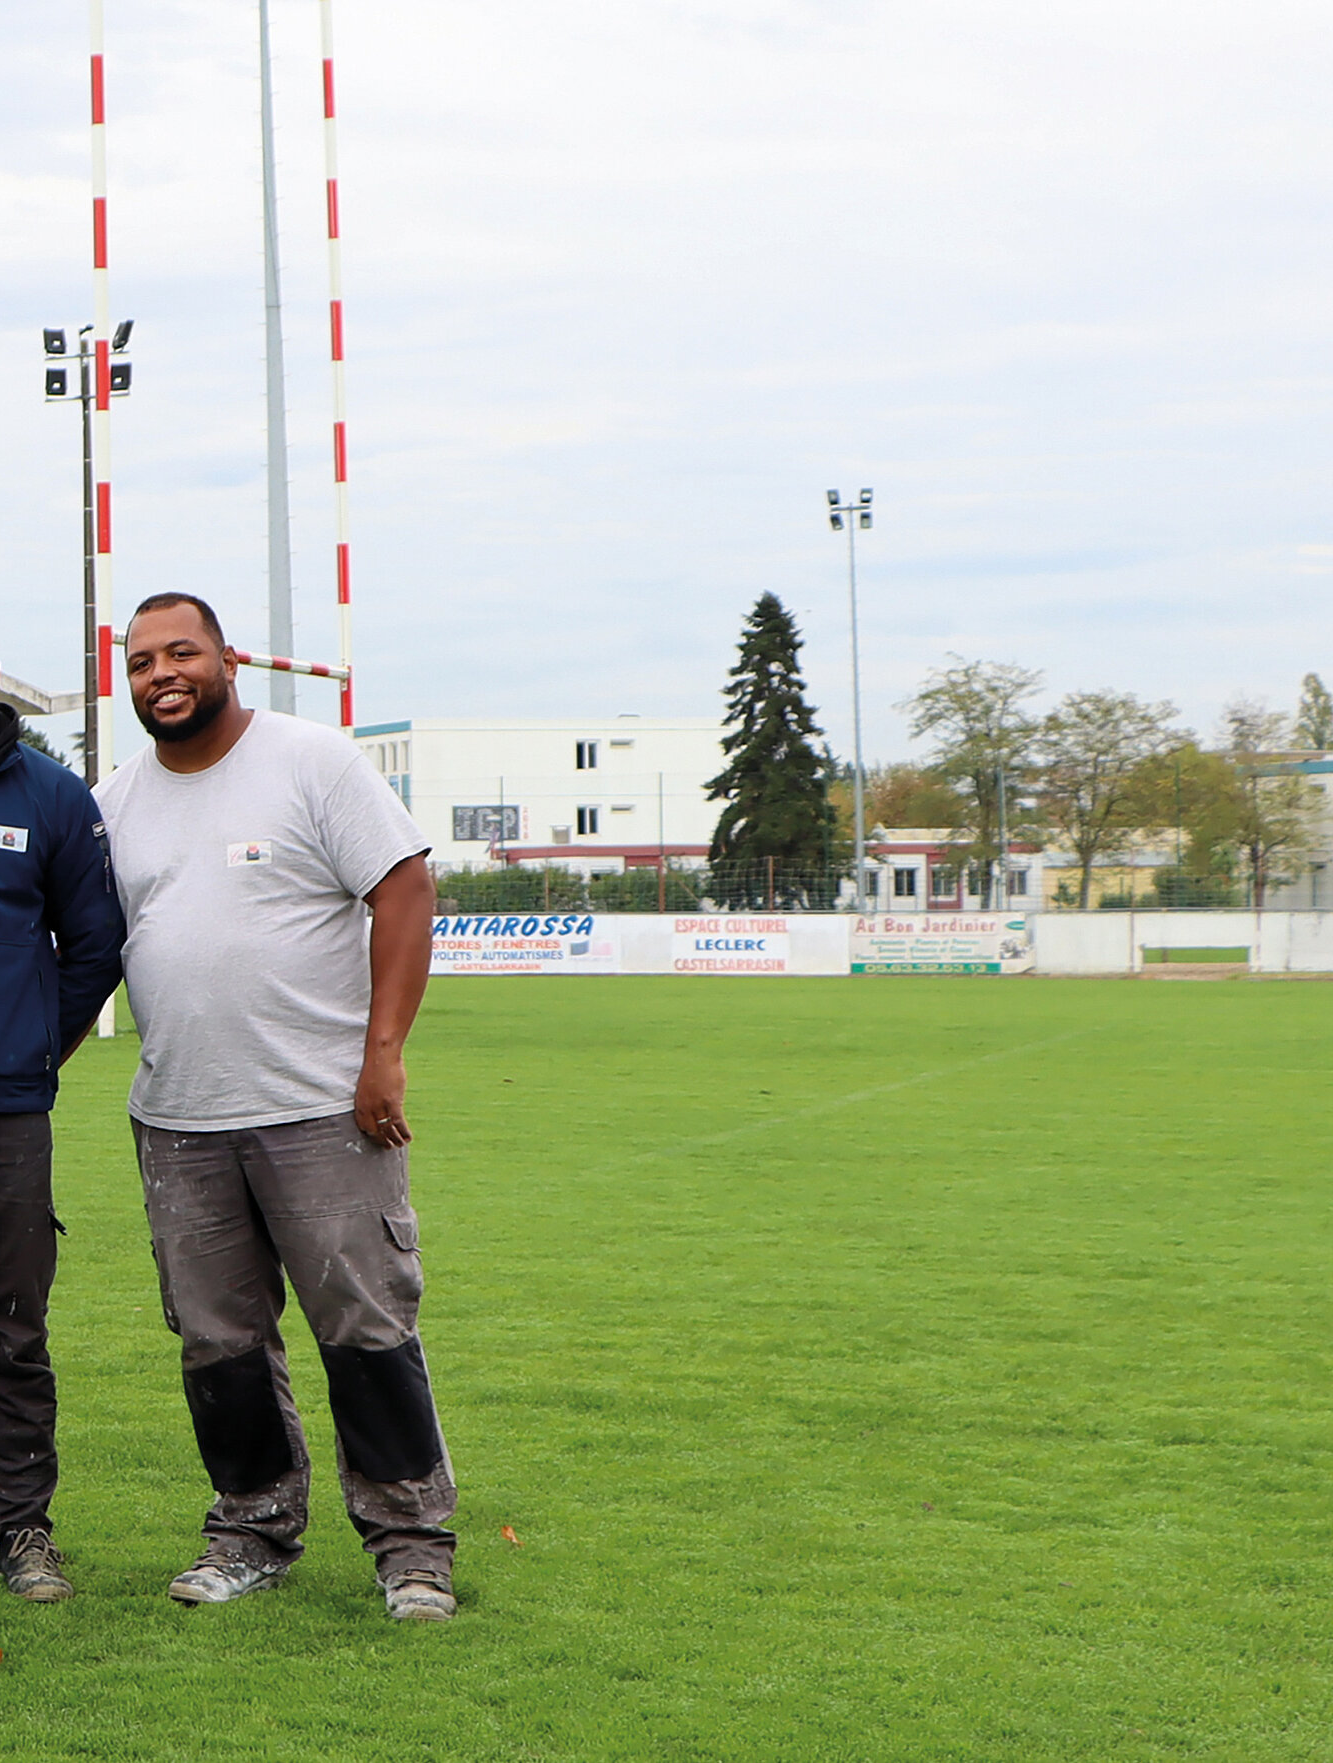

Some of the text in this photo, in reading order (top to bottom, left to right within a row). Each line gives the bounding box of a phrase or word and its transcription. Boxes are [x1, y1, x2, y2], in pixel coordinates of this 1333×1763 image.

[431, 914, 595, 937] ANTAROSSA
[675, 918, 788, 933] ESPACE CULTUREL
[855, 917, 997, 933] Au Bon Jardinier
[433, 939, 483, 950] STORES
[494, 937, 561, 949] FENÊTRES
[695, 938, 766, 951] LECLERC
[433, 951, 473, 961] VOLETS
[482, 950, 564, 961] AUTOMATISMES
[674, 958, 786, 971] CASTELSARRASIN
